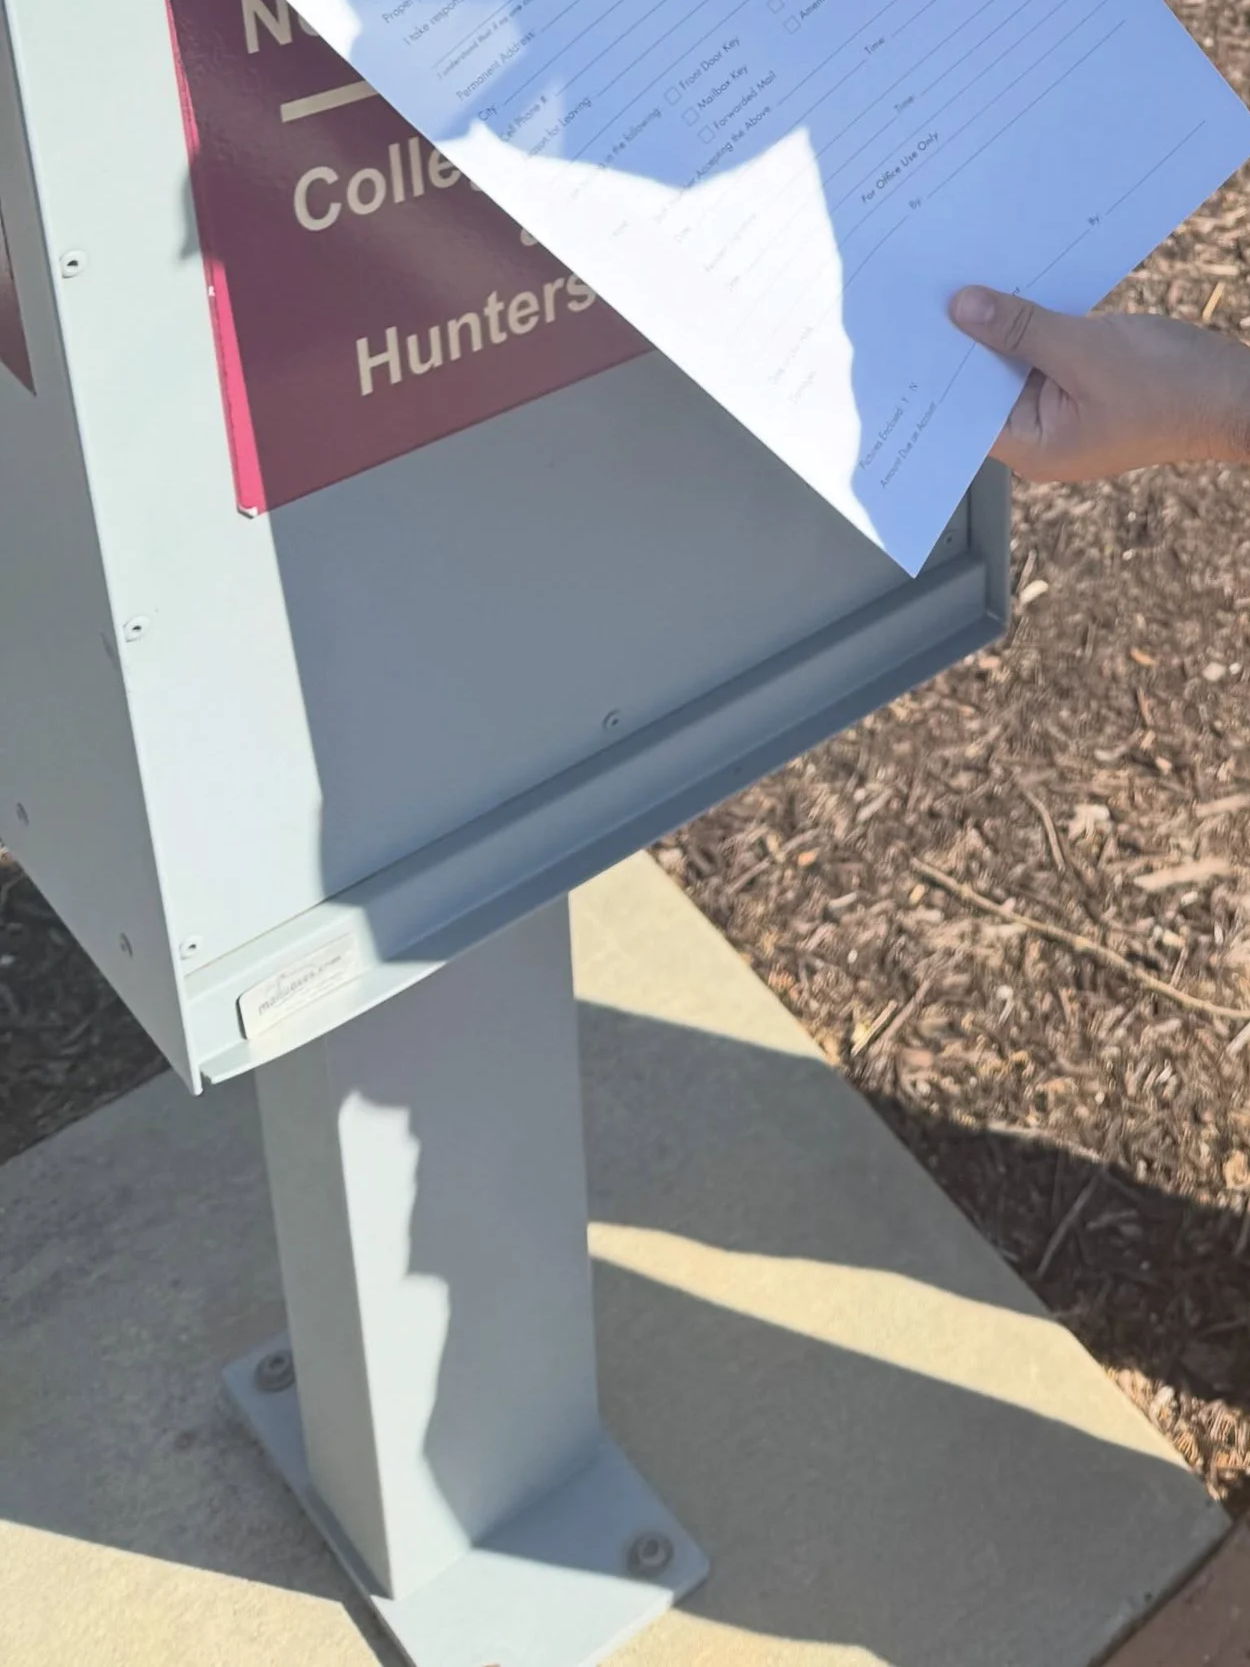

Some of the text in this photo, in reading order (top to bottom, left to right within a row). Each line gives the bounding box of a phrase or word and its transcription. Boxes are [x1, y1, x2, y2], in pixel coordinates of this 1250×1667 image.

[695, 64, 749, 109] Mailbox Key
[698, 49, 723, 72] Door
[720, 37, 741, 54] Key
[711, 68, 777, 131] Forwarded Mail
[293, 136, 483, 232] Colle
[859, 131, 939, 204] For Office Use Only
[355, 272, 598, 397] Hunters
